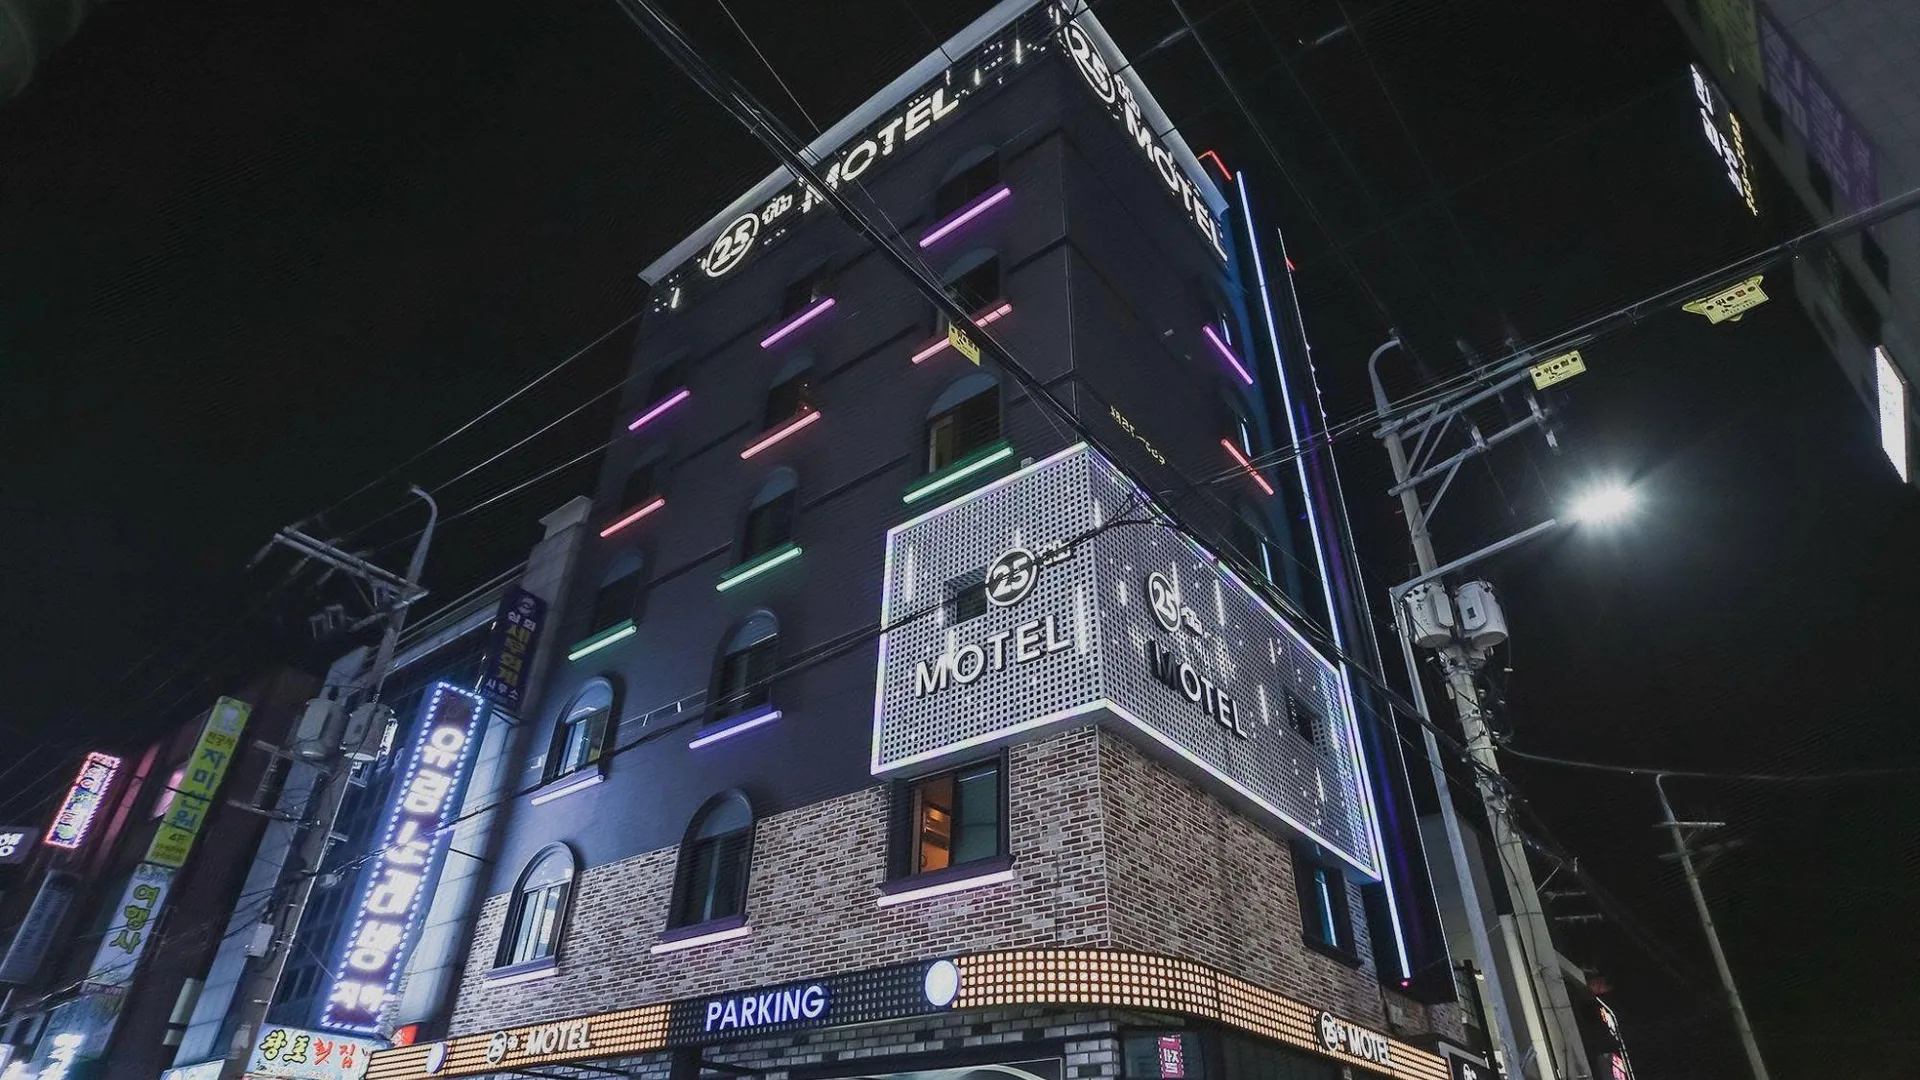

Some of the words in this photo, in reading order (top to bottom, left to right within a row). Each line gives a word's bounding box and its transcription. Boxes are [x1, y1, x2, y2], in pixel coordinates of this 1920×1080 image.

[1125, 103, 1228, 261] MOTEL
[915, 615, 1072, 697] MOTEL
[1146, 640, 1247, 738] MOTEL
[347, 725, 466, 972] 유림노래방
[109, 884, 161, 955] 여행사
[524, 1021, 591, 1056] MOTEL
[706, 985, 825, 1031] PARKING
[1347, 1026, 1395, 1067] MOTEL
